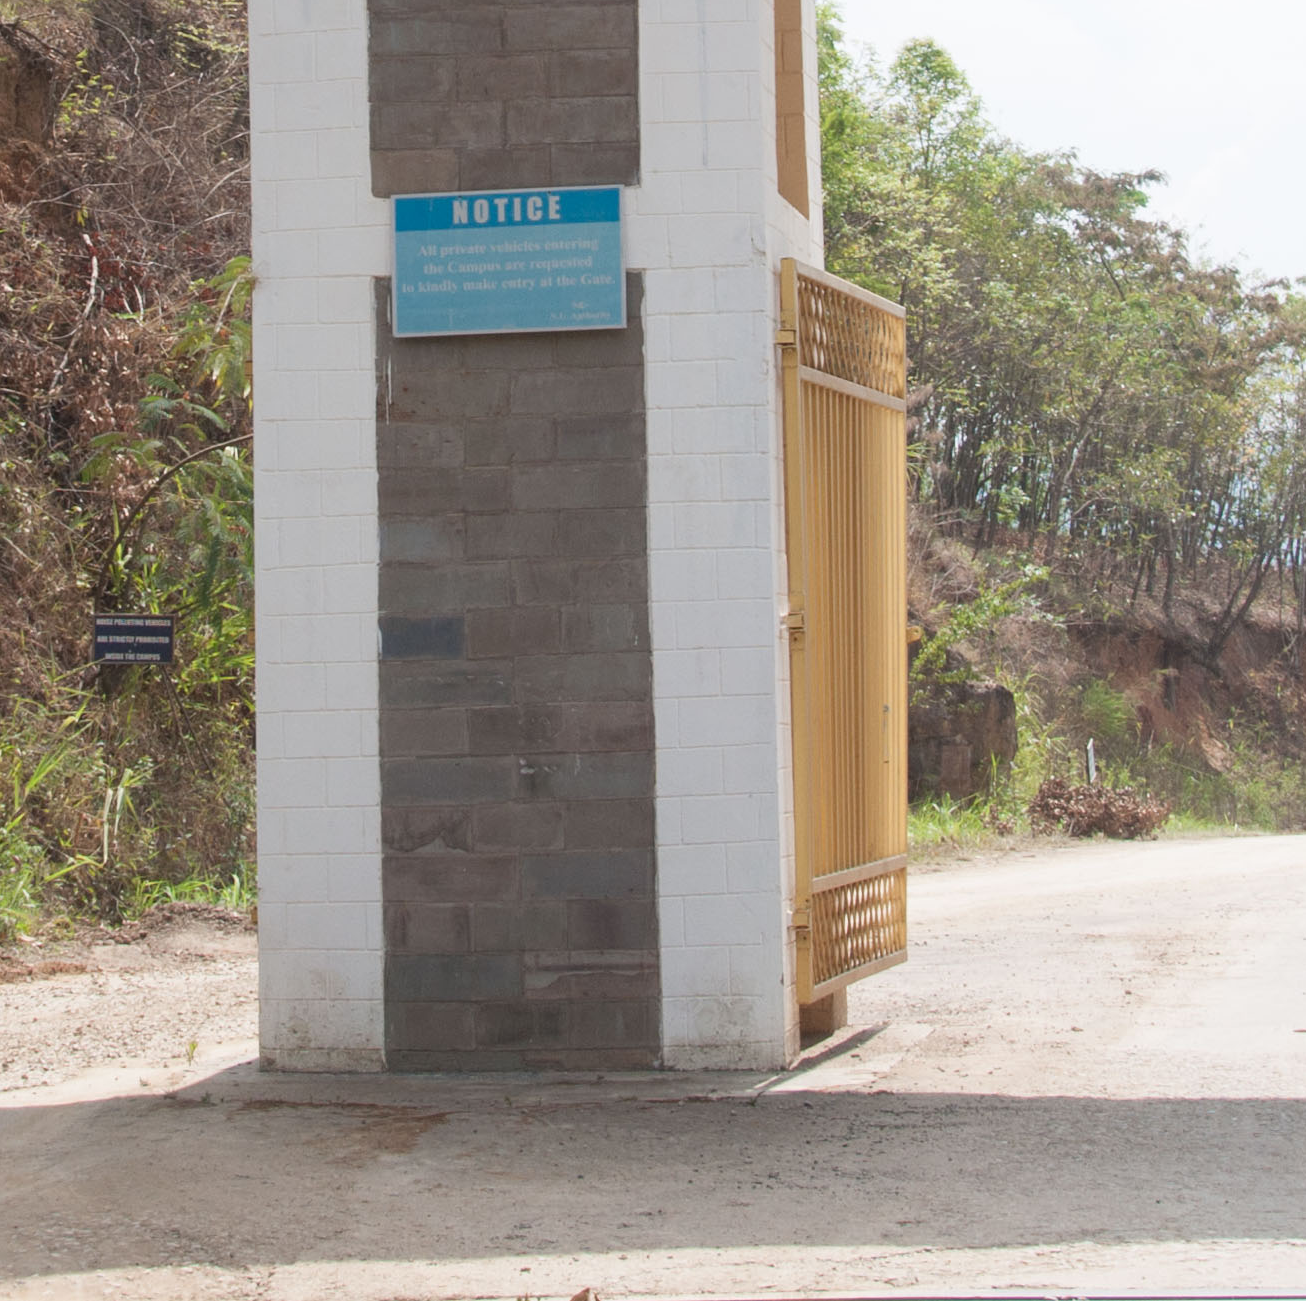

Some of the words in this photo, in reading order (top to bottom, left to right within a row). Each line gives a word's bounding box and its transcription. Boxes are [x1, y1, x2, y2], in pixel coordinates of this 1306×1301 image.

[452, 195, 561, 224] NOTICE
[418, 244, 437, 257] All
[440, 242, 486, 258] private
[489, 240, 541, 253] vehicles
[544, 237, 599, 252] entering
[423, 261, 444, 275] the
[447, 259, 502, 276] Campus
[505, 260, 526, 271] are
[529, 255, 593, 273] requested
[401, 283, 414, 294] to
[418, 279, 458, 294] kindly
[462, 277, 498, 291] make
[502, 276, 535, 290] entry
[540, 275, 553, 287] at
[556, 274, 577, 287] the
